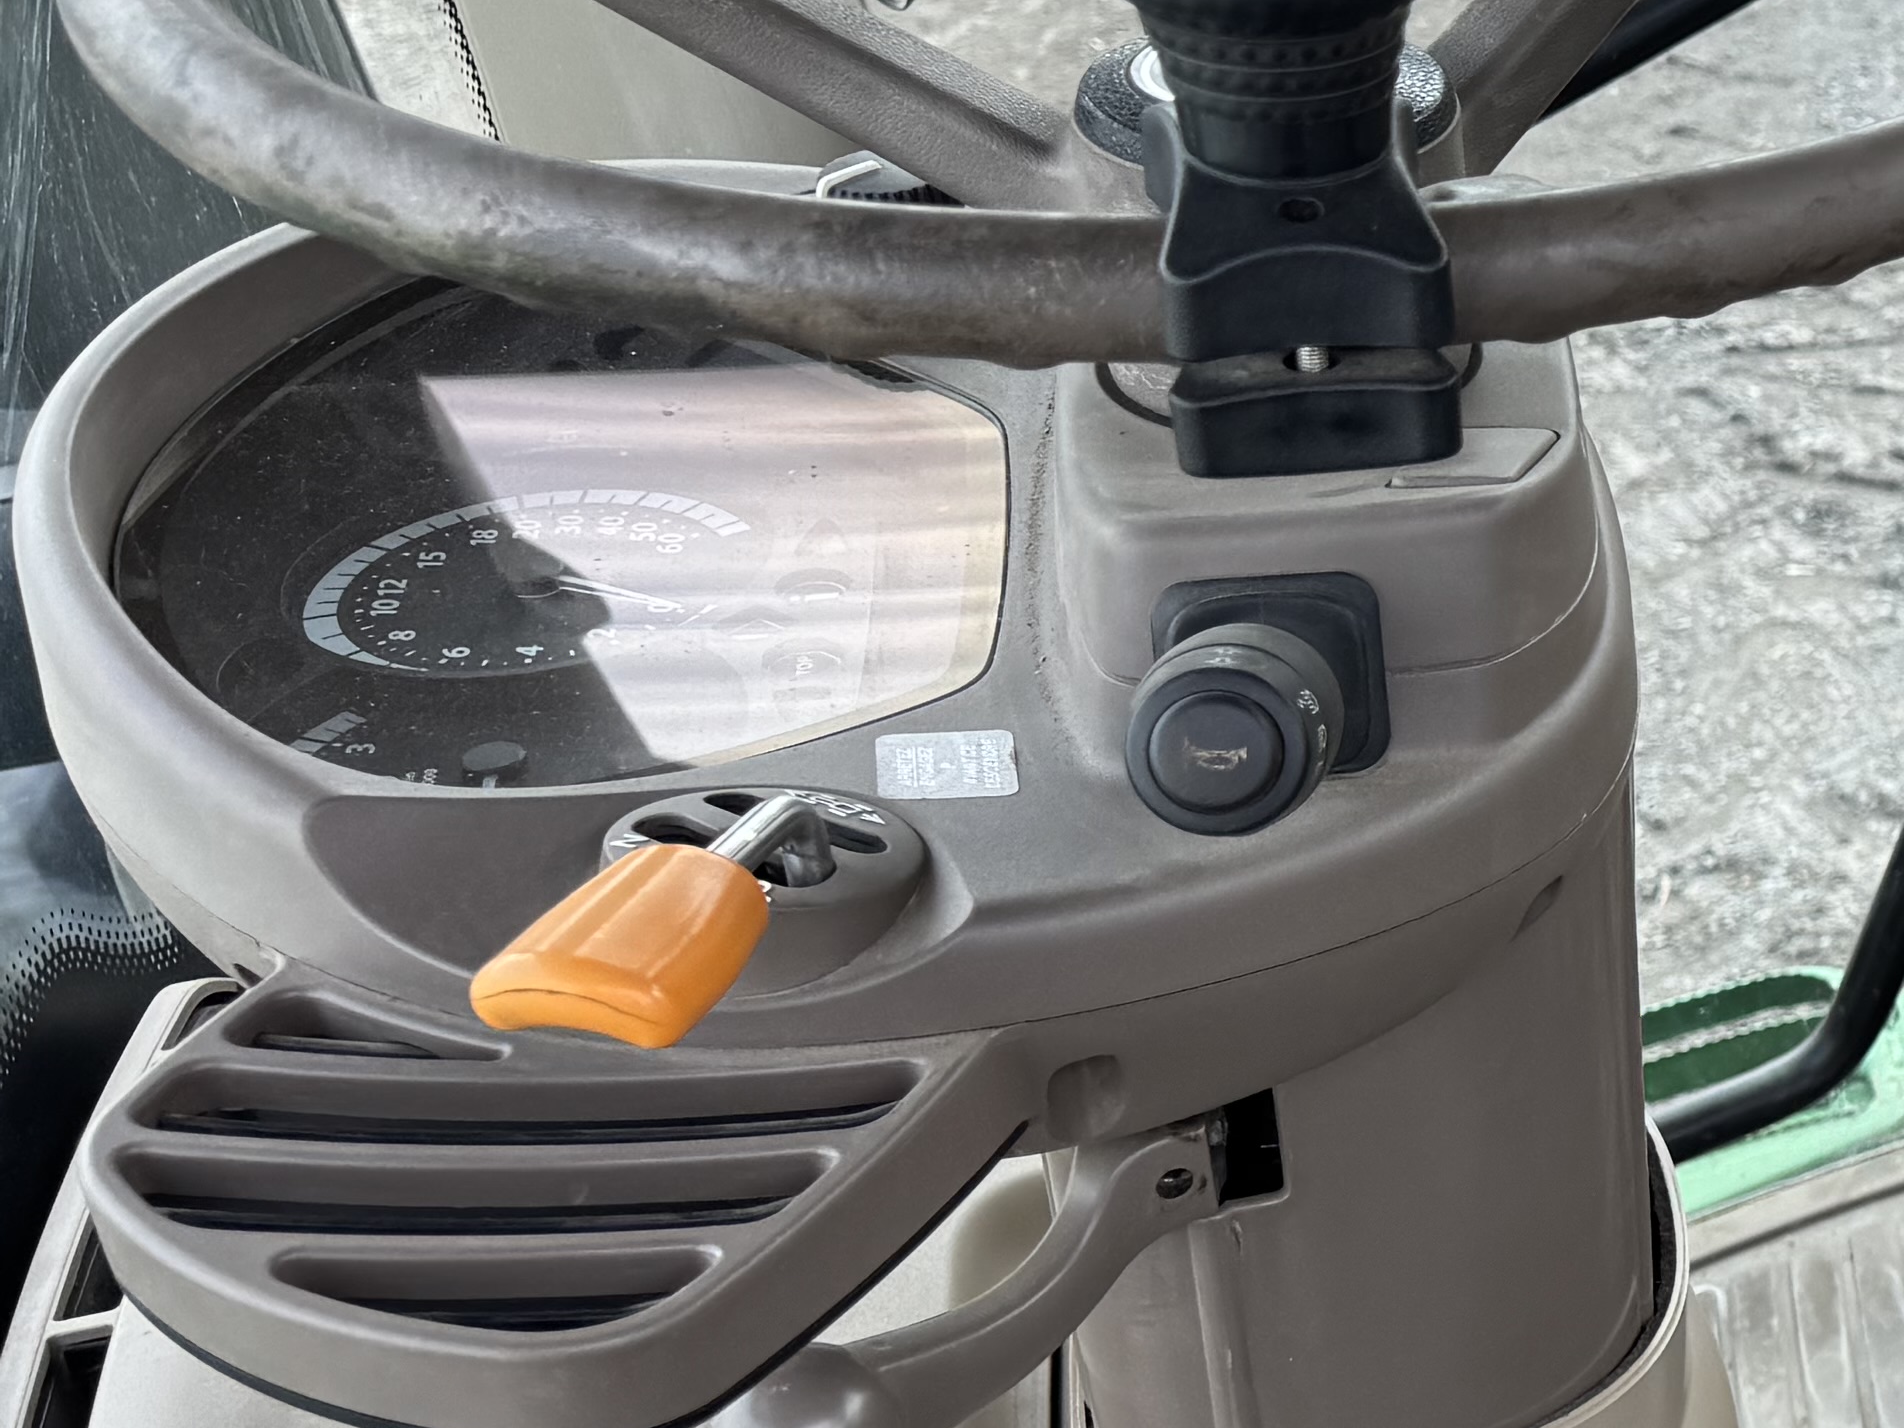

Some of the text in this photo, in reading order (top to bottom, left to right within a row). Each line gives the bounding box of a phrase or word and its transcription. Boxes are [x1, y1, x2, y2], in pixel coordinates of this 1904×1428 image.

[511, 516, 543, 540] 20
[554, 515, 584, 535] 30
[594, 515, 625, 537] 40
[629, 520, 659, 543] 50
[469, 528, 499, 546] 18
[655, 532, 687, 554] 60
[416, 550, 447, 569] 15
[376, 578, 409, 597] 12
[369, 598, 401, 617] 10
[387, 629, 417, 642] 8
[586, 627, 617, 640] 2
[441, 646, 472, 660] 6
[515, 644, 545, 658] 4
[794, 655, 814, 681] TOP
